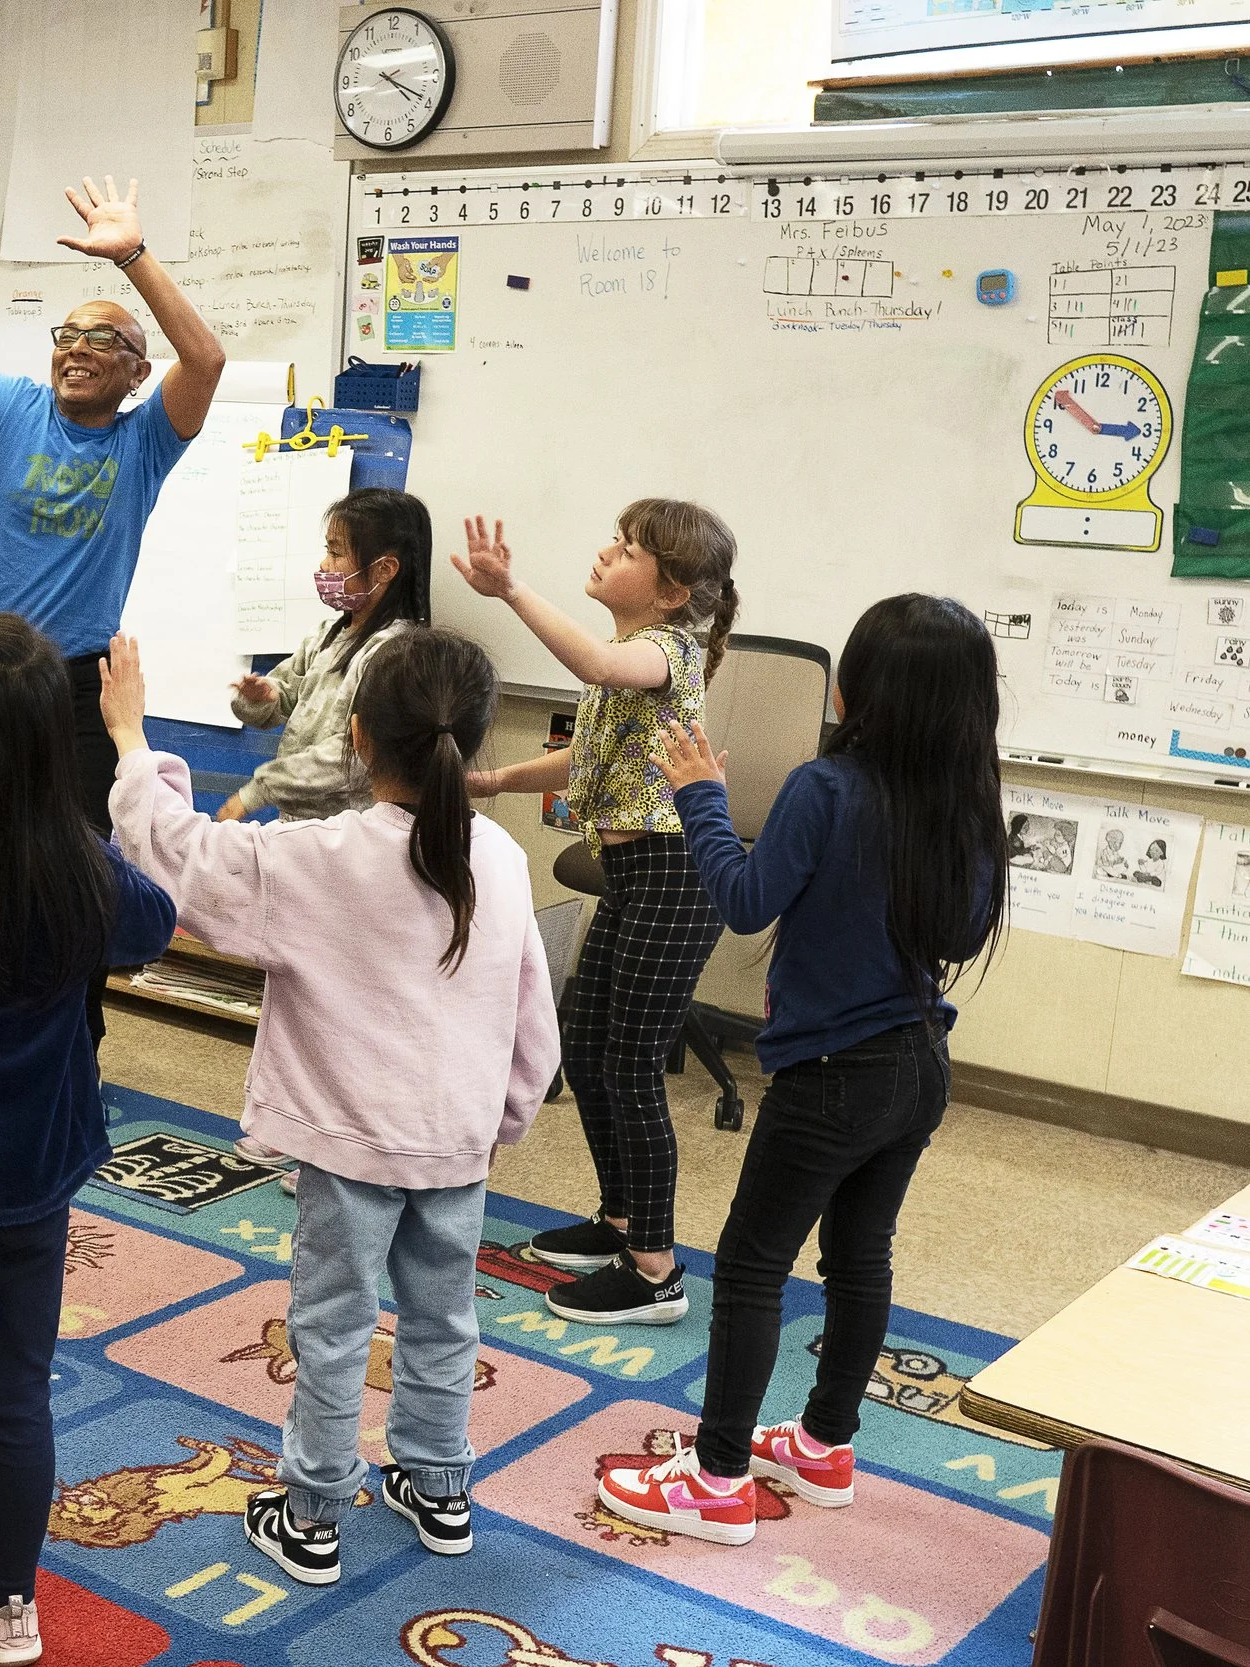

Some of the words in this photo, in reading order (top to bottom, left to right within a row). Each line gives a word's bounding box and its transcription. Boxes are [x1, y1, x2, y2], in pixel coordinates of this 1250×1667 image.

[388, 16, 400, 30] 12
[414, 23, 419, 36] 1
[365, 27, 374, 40] 11
[349, 47, 360, 61] 10
[342, 76, 350, 89] 9
[347, 103, 355, 117] 8
[424, 97, 432, 110] 4
[363, 122, 370, 135] 7
[407, 119, 414, 132] 5
[384, 127, 392, 141] 6
[761, 199, 781, 218] 13
[797, 197, 816, 216] 14
[834, 196, 854, 215] 15
[870, 194, 891, 214] 16
[907, 193, 930, 213] 17
[947, 191, 969, 212] 18
[985, 190, 1009, 211] 19
[1024, 189, 1049, 210] 20
[1066, 187, 1088, 208] 21
[1107, 186, 1133, 208] 22
[1150, 185, 1177, 206] 23
[1195, 182, 1221, 205] 24
[374, 207, 381, 224] 1
[401, 206, 410, 223] 2
[429, 204, 438, 223] 3
[458, 203, 468, 221] 4
[489, 203, 498, 220] 5
[520, 201, 530, 219] 6
[551, 200, 561, 218] 7
[582, 198, 592, 217] 8
[614, 197, 624, 216] 9
[645, 196, 662, 215] 10
[676, 195, 694, 215] 11
[711, 194, 731, 214] 12
[780, 223, 811, 240] Mrs.
[823, 221, 888, 240] Feibus
[1082, 215, 1126, 239] May
[1163, 213, 1206, 231] 2023
[390, 242, 410, 250] Wash
[411, 241, 429, 250] Your
[429, 239, 457, 250] Hands
[577, 235, 646, 264] Welcome
[662, 237, 681, 259] to
[1106, 237, 1178, 257] 5/1/23
[419, 262, 437, 275] SOAP
[1052, 260, 1079, 274] Table
[1091, 259, 1128, 269] Points
[580, 273, 627, 298] Room
[1073, 379, 1085, 394] 11
[1095, 372, 1111, 387] 12
[1123, 379, 1129, 394] 1
[1136, 397, 1148, 412] 2
[1043, 418, 1053, 433] 9
[1142, 423, 1152, 438] 3
[1048, 443, 1058, 458] 8
[1131, 446, 1142, 461] 4
[1065, 461, 1076, 476] 7
[1087, 468, 1097, 483] 6
[1112, 462, 1123, 477] 5
[1056, 600, 1087, 616] Today
[1129, 606, 1164, 624] Monday
[1059, 620, 1106, 638] Yesterday
[1118, 627, 1158, 648] Sunday
[1066, 635, 1087, 643] was
[1051, 646, 1102, 660] Tomorrow
[1116, 655, 1157, 674] Tuesday
[1055, 660, 1074, 668] will
[1079, 660, 1092, 671] be
[1049, 673, 1083, 692] Today
[1184, 671, 1225, 693] Friday
[1168, 701, 1224, 725] Wednesday
[1116, 730, 1158, 749] money
[1009, 790, 1035, 808] Talk
[1042, 796, 1065, 812] Move
[1104, 804, 1129, 819] Talk
[1138, 808, 1171, 826] Move
[1217, 823, 1250, 843] Tal
[1091, 894, 1126, 910] disagree
[1131, 902, 1157, 915] with
[446, 1500, 466, 1511] NIKE
[313, 1529, 334, 1541] NIKE
